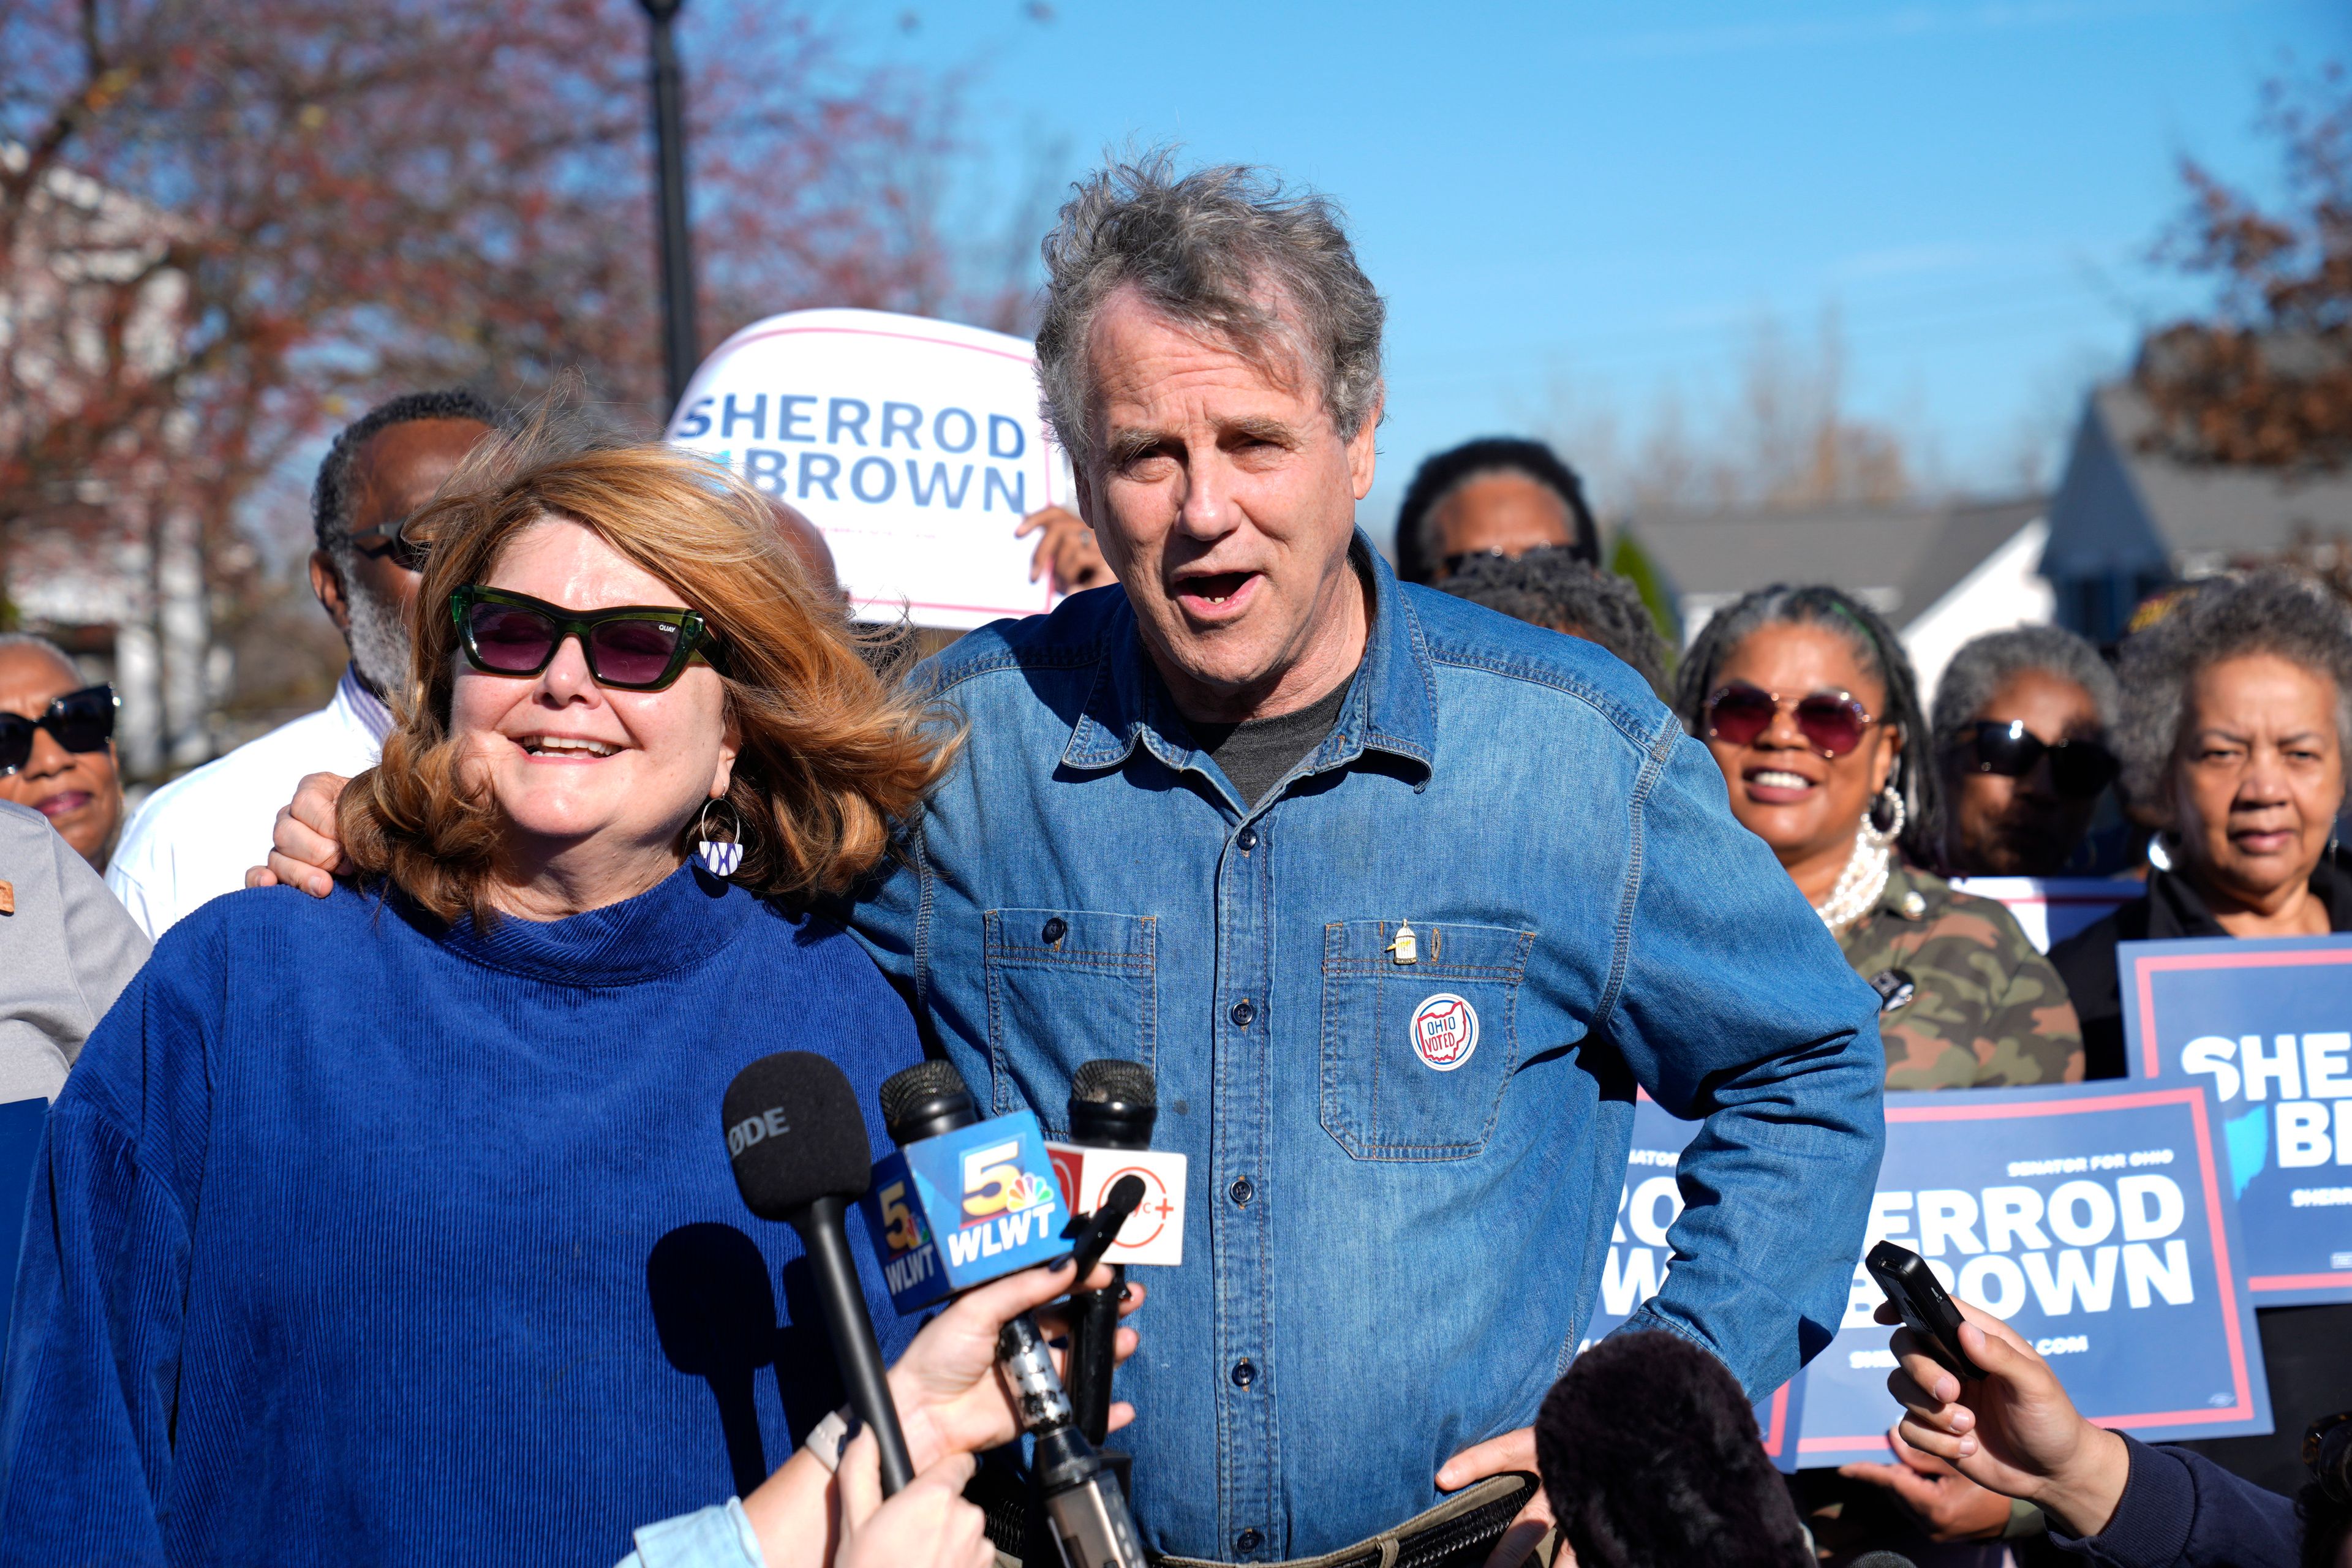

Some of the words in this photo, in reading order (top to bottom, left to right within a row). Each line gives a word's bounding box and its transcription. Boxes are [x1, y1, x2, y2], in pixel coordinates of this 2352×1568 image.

[674, 393, 1026, 460] SHERROD
[745, 447, 1026, 515] BROWN
[658, 624, 677, 633] QUAY
[1425, 1032, 1455, 1052] VOTED
[1427, 1016, 1456, 1035] OHIO
[2180, 1031, 2352, 1102] SHE
[962, 1140, 1022, 1216] 5
[2089, 1153, 2125, 1170] FOR
[880, 1180, 911, 1250] 5
[948, 1202, 1055, 1268] WLWT
[886, 1244, 935, 1295] WLWT
